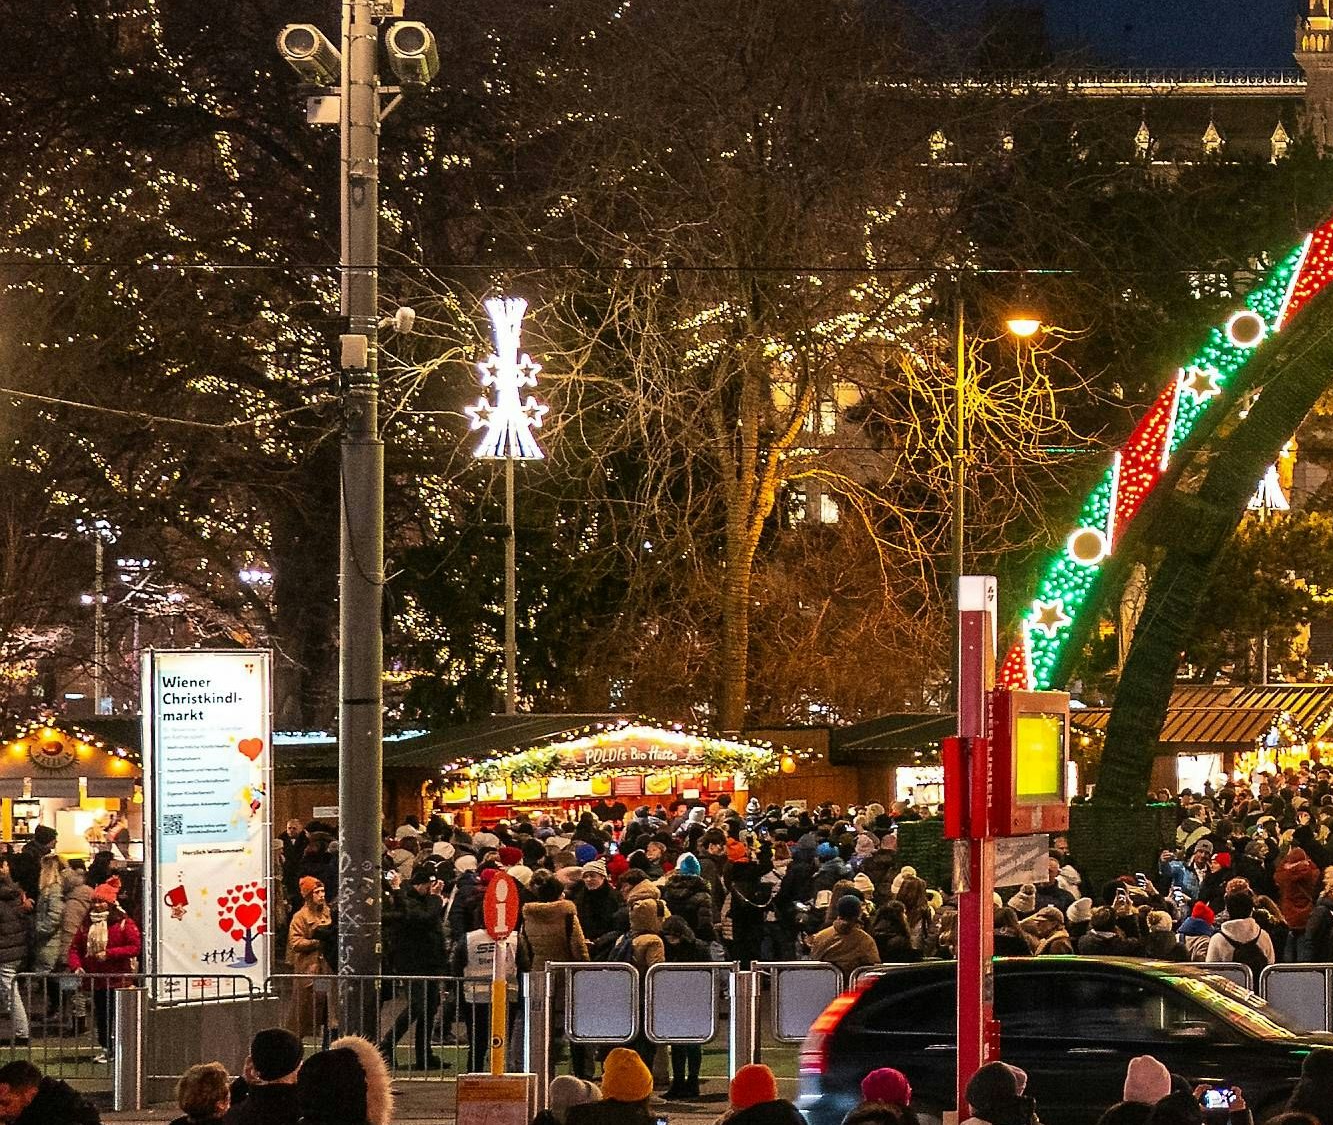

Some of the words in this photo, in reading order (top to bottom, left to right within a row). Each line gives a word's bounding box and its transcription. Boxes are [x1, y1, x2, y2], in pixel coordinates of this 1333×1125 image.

[162, 676, 212, 688] Wiener
[162, 692, 242, 705] Christkindl-
[162, 709, 204, 721] markt
[630, 746, 647, 760] Bio
